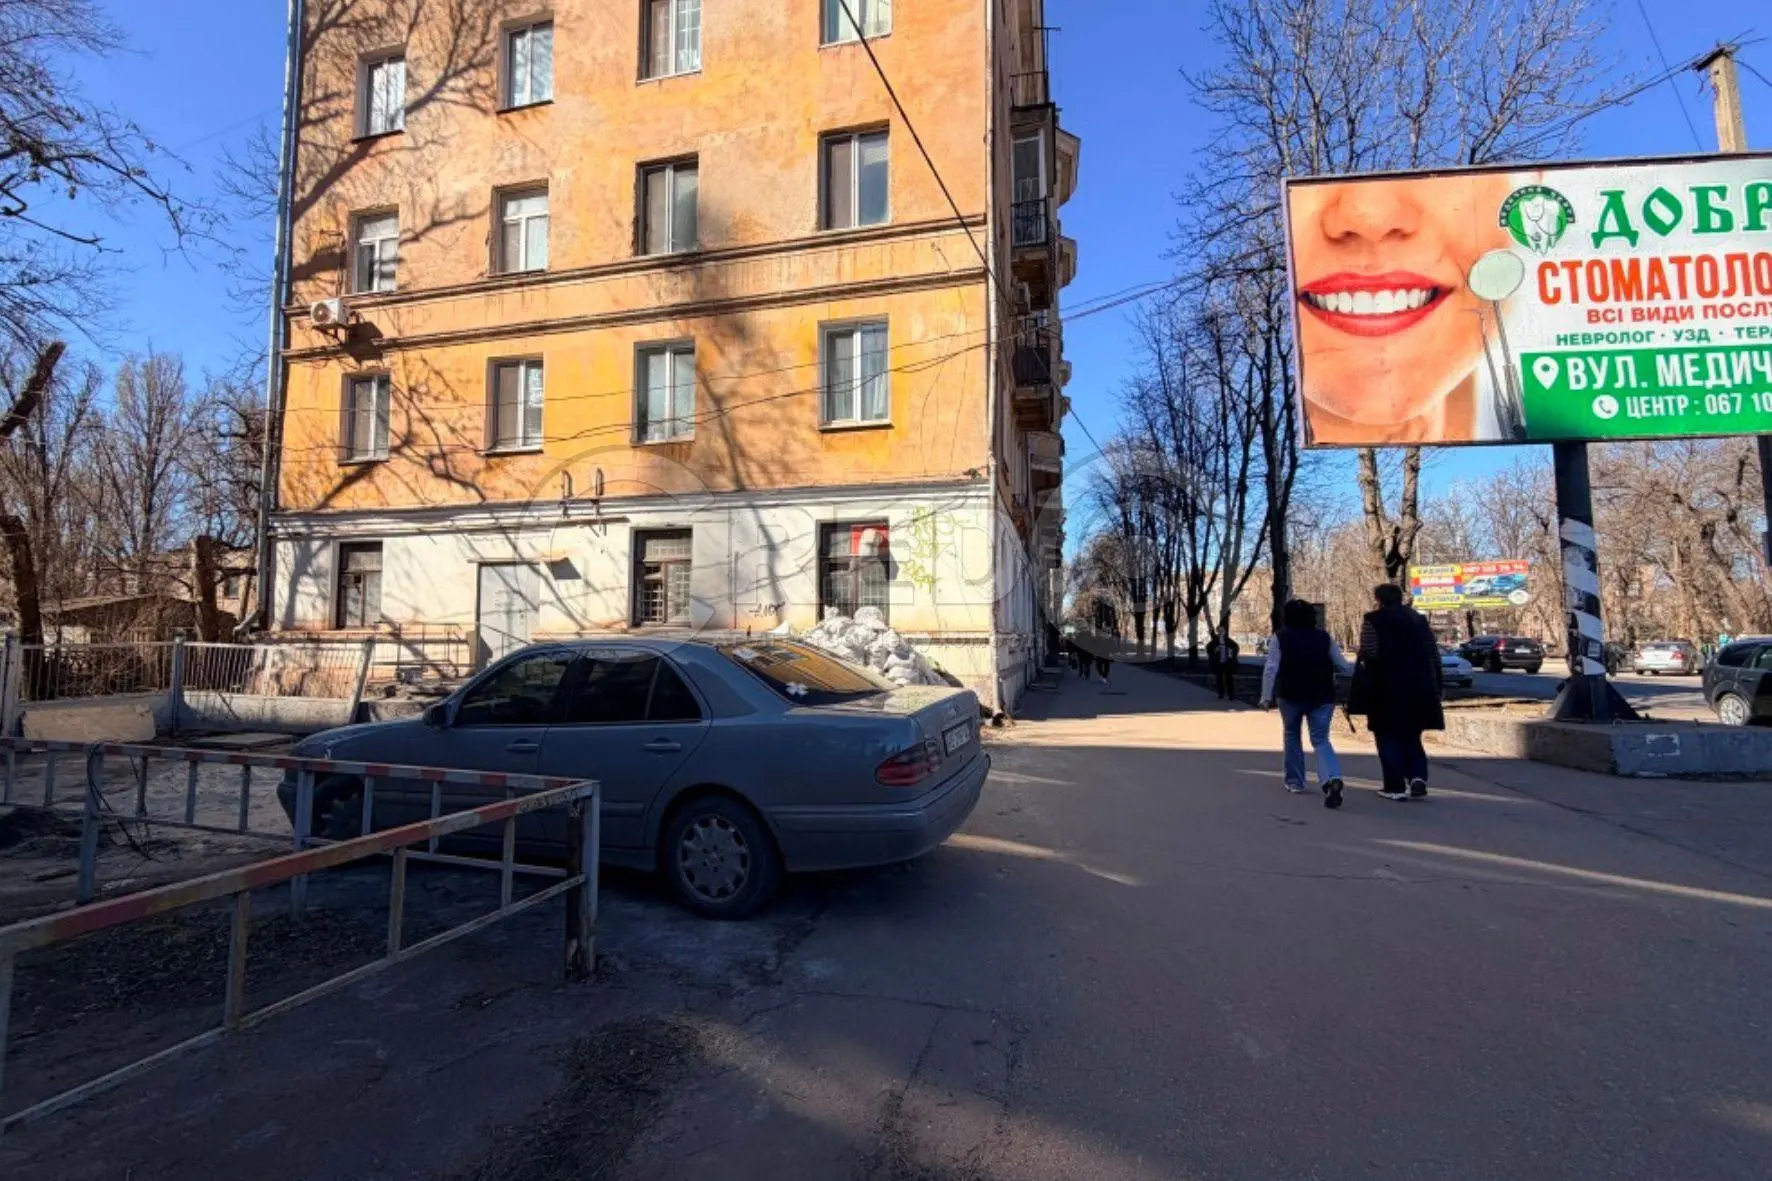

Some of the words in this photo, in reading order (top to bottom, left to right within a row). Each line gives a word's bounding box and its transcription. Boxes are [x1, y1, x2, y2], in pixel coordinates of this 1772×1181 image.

[1590, 182, 1772, 249] ДОБР
[1536, 252, 1772, 305] СТОМАТОЛО
[1586, 308, 1623, 324] ВСІ
[1631, 305, 1694, 324] ВИДИ
[1556, 331, 1656, 347] НЕВРОЛОГ
[1672, 328, 1712, 344] УЗД
[1733, 325, 1772, 340] ТЕР
[1565, 354, 1649, 391] ВУЛ.
[1655, 350, 1772, 390] МЕДИЧ
[1703, 392, 1743, 415] 067
